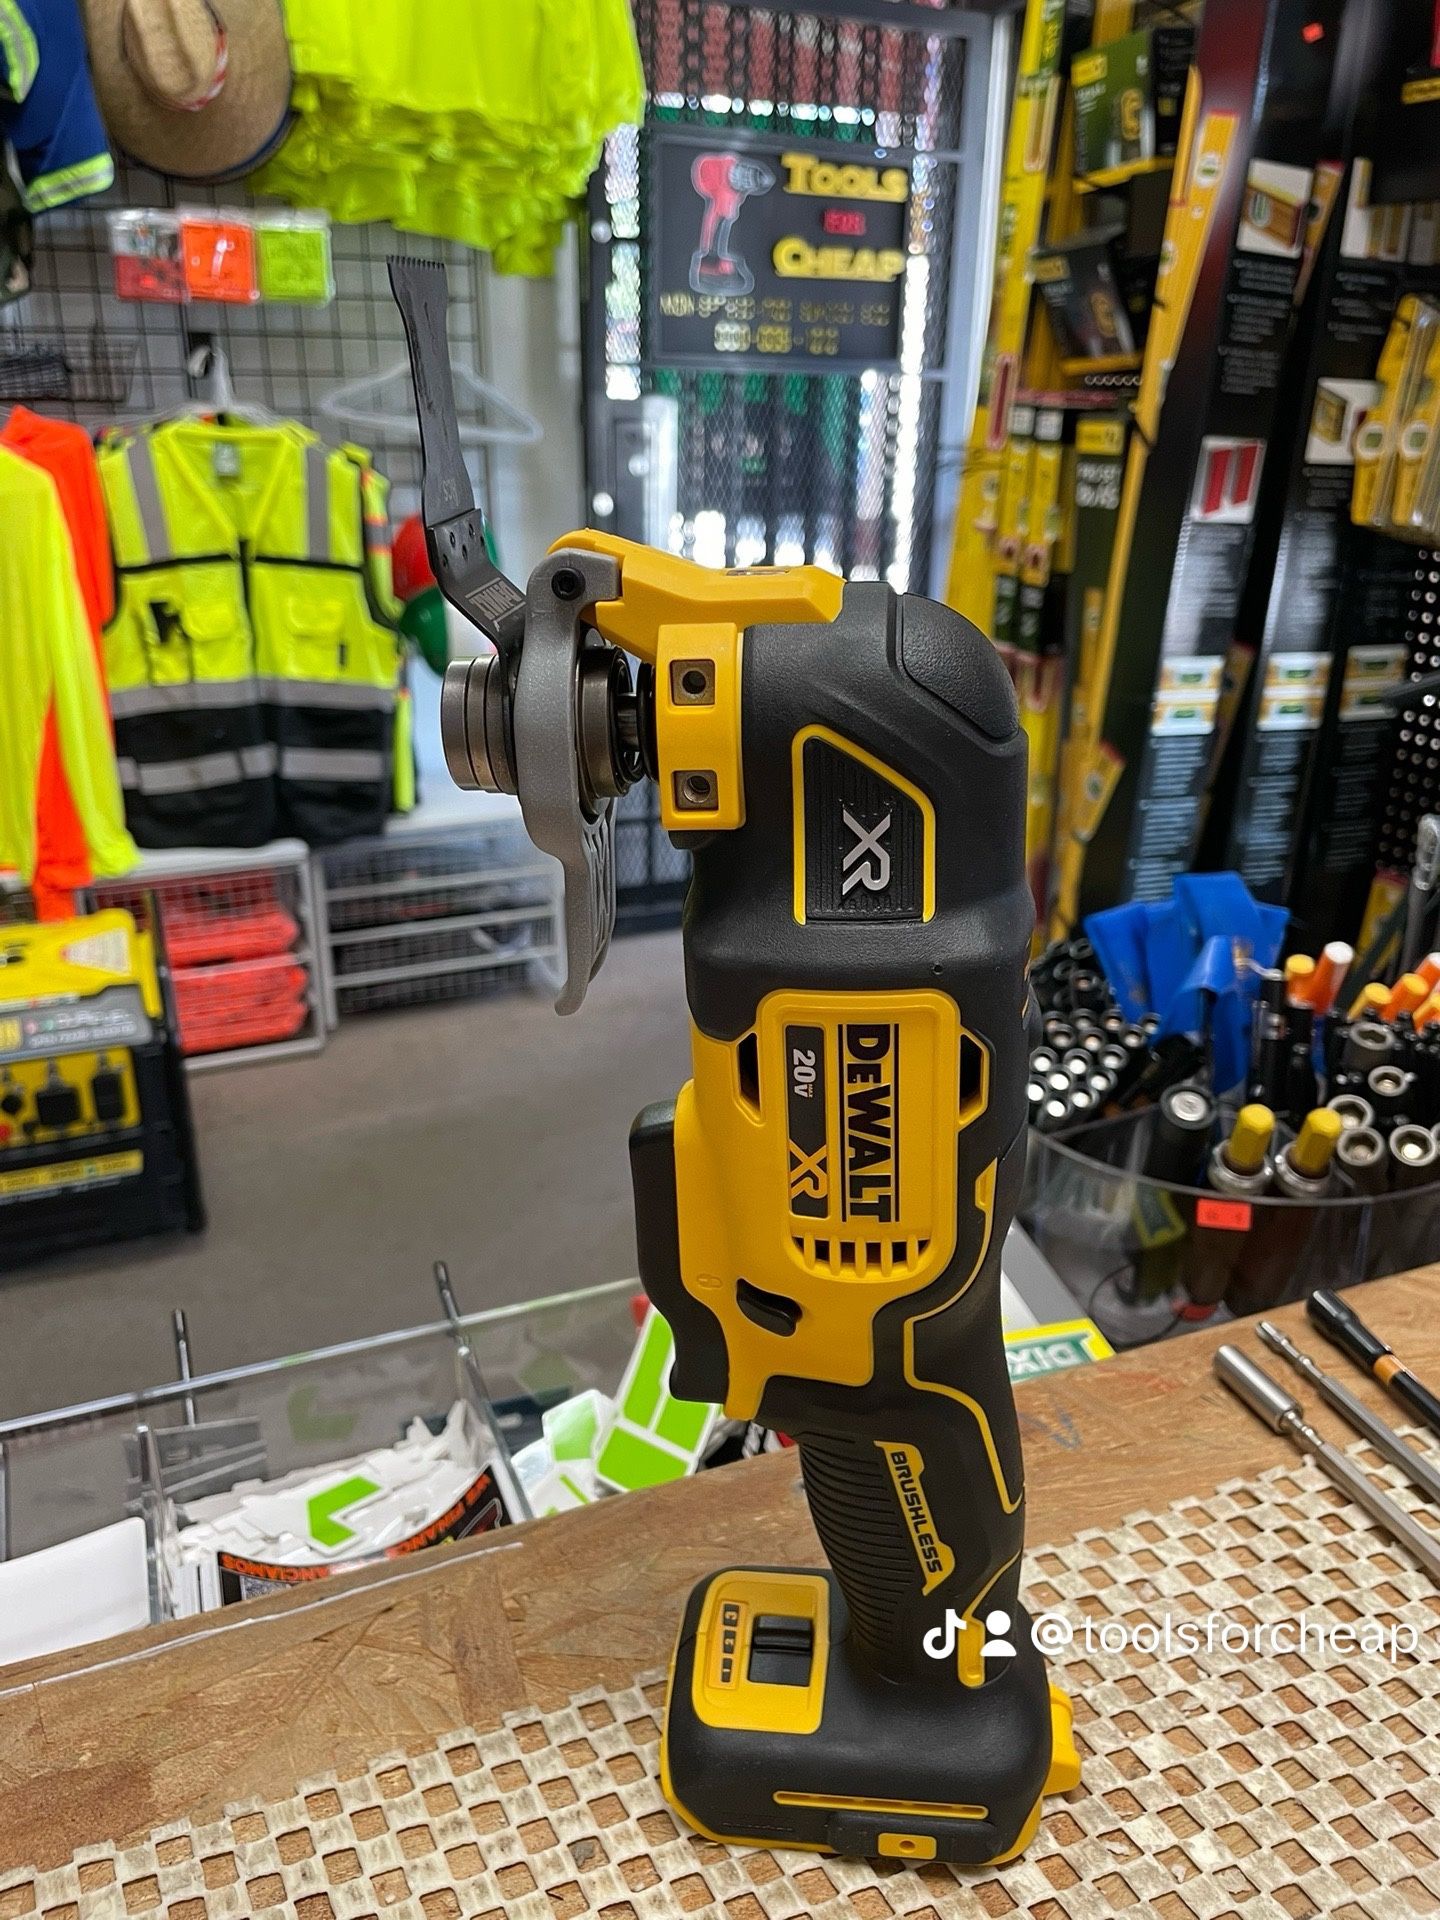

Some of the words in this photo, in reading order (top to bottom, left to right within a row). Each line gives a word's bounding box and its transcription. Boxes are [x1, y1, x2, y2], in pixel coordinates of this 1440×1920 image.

[781, 152, 908, 202] TOOLS
[773, 237, 906, 282] CHEAP
[842, 808, 890, 896] XR
[846, 1023, 892, 1223] DEWALT
[788, 1138, 828, 1200] XR
[890, 1451, 943, 1573] BRUSHLESS
